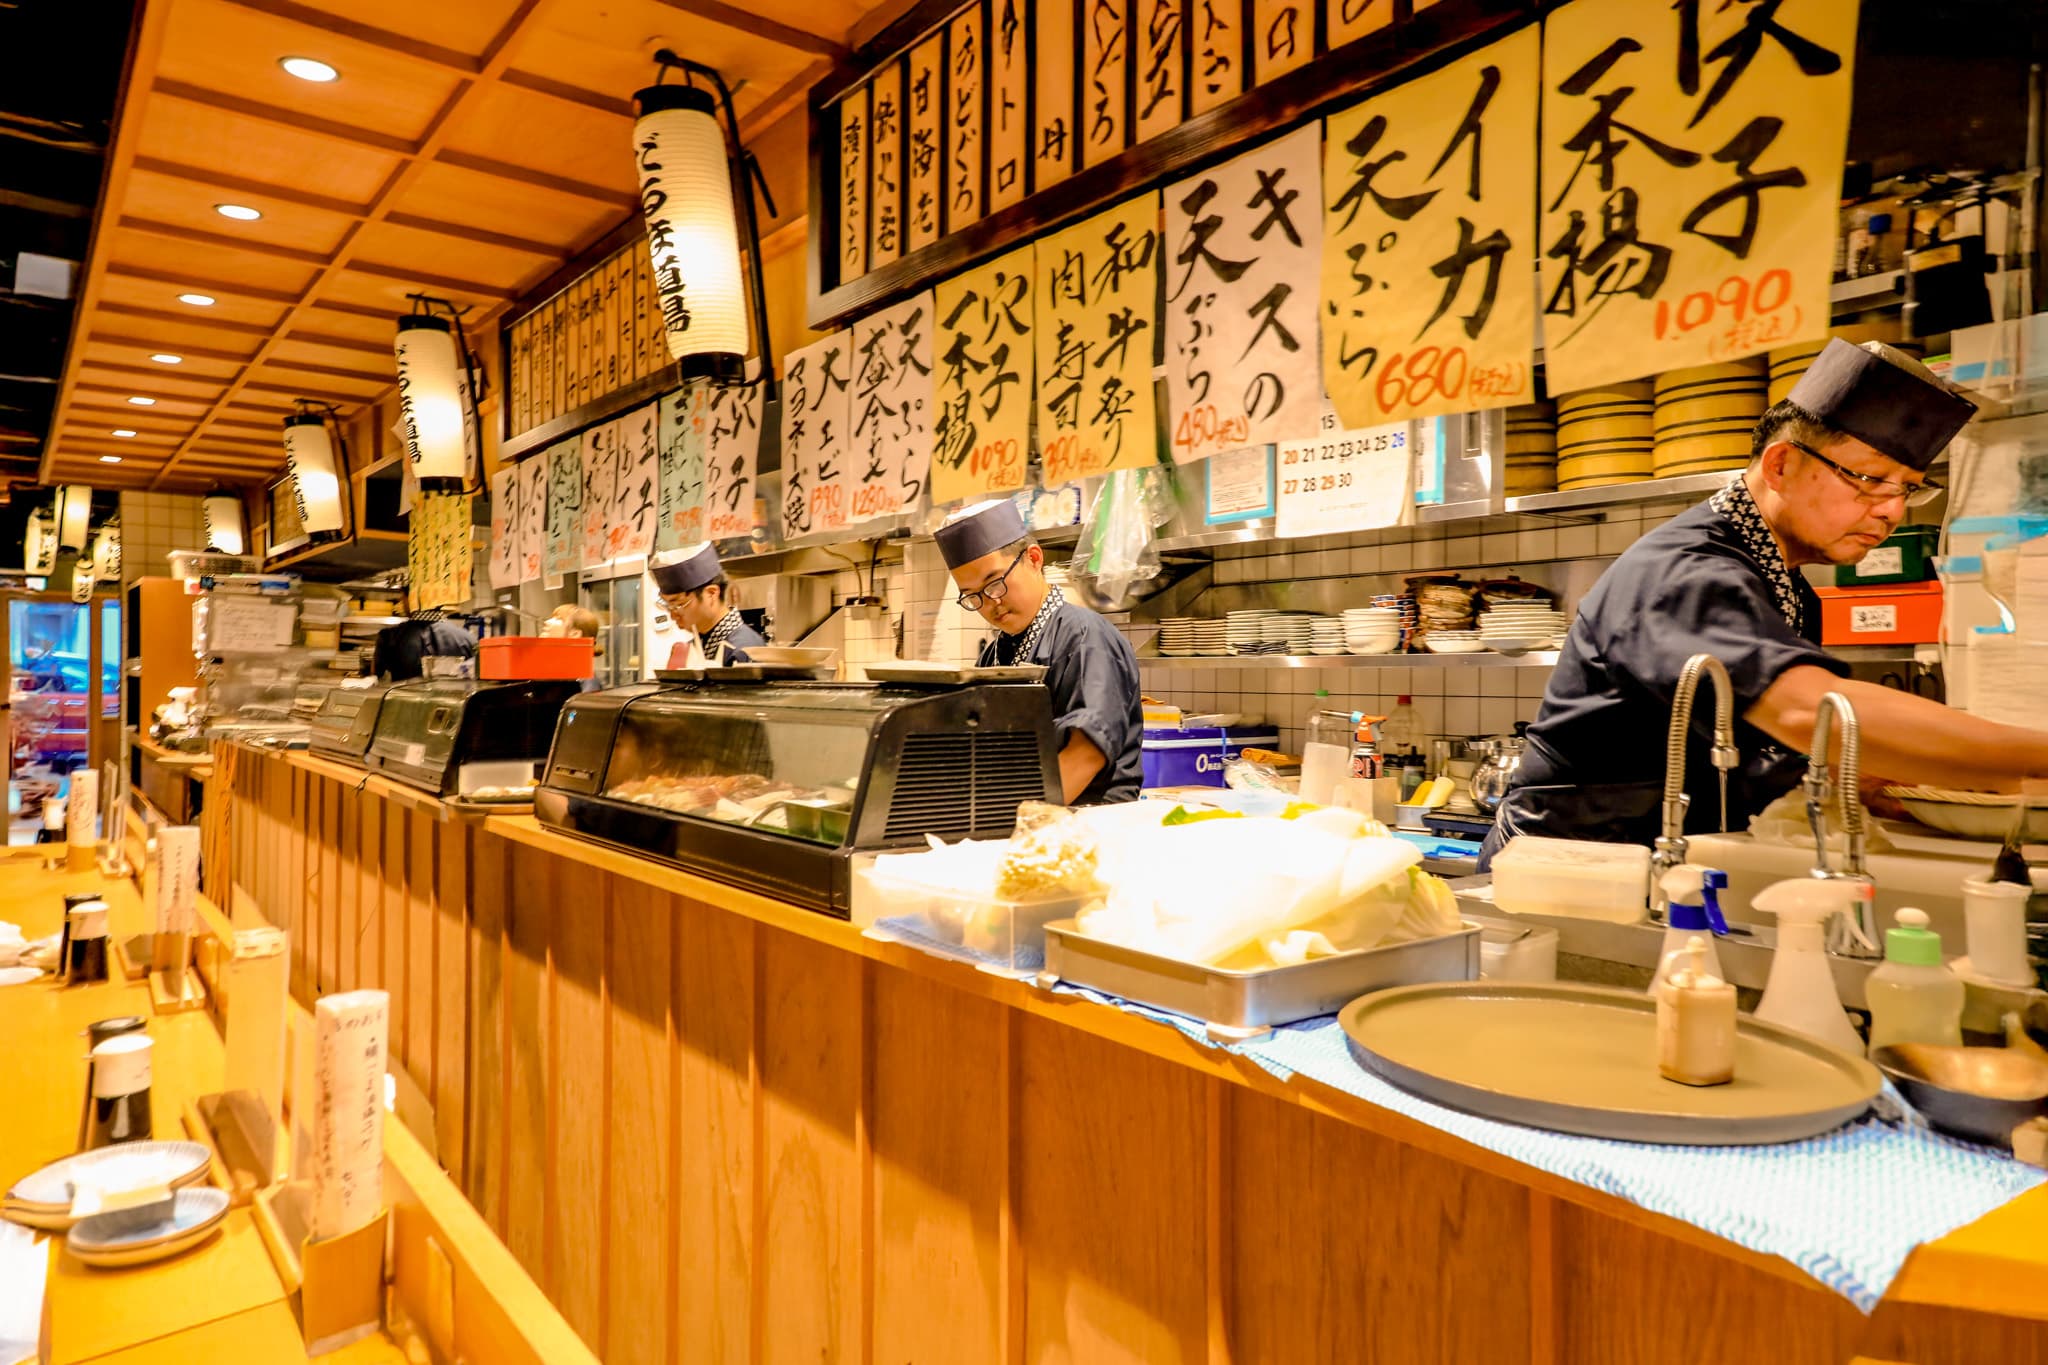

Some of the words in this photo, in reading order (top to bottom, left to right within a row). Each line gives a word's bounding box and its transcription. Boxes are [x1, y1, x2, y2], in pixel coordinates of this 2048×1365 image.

[954, 24, 978, 212] のどぐろ
[1416, 65, 1512, 341] イカ
[1543, 37, 1703, 349] 一本揚
[1168, 179, 1260, 406] 天ぷら
[1236, 167, 1304, 424] キスの
[1329, 114, 1444, 382] 天ぷら
[810, 347, 851, 482] 大エビ
[893, 307, 933, 505] 天ぷら
[934, 290, 989, 471] 一本揚
[980, 273, 1031, 423] 穴子
[1044, 250, 1096, 432] 肉寿司
[1321, 415, 1335, 429] 15
[1283, 479, 1297, 494] 27
[1303, 477, 1316, 492] 28
[1321, 474, 1335, 490] 29
[1339, 472, 1352, 488] 30
[1284, 449, 1298, 465] 20
[1303, 448, 1316, 463] 21
[1321, 445, 1335, 460] 22
[1339, 441, 1353, 457] 23
[1357, 439, 1371, 455] 24
[1374, 435, 1388, 452] 25
[1391, 432, 1405, 449] 26
